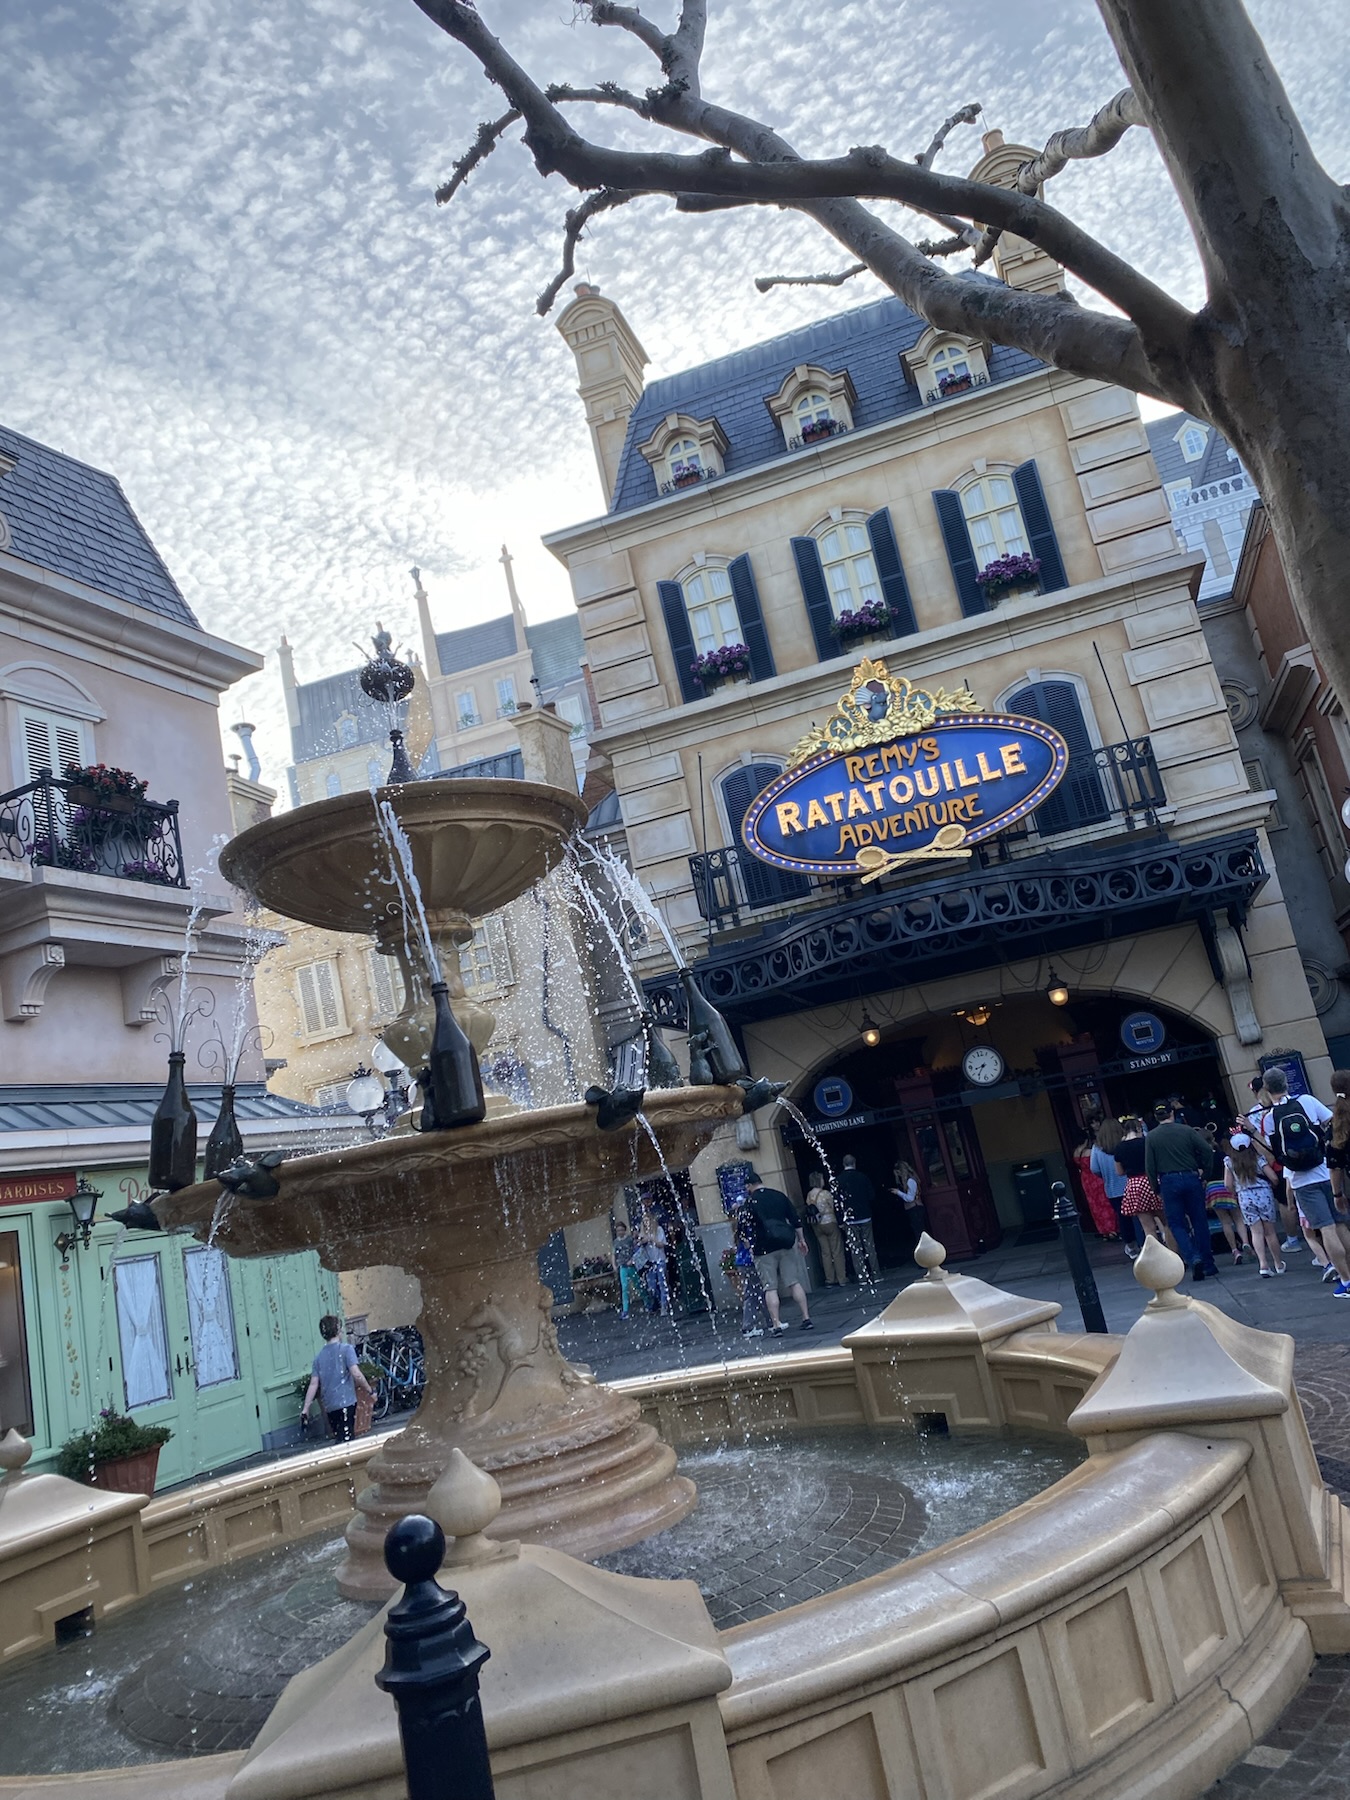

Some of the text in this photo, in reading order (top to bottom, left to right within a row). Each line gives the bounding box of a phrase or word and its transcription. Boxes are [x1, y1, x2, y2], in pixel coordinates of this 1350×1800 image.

[844, 737, 941, 782] REMY'S
[775, 743, 1027, 836] RATATOUILLE
[835, 793, 984, 855] ADVENTURE
[1130, 1054, 1171, 1069] STAND-BY
[815, 1116, 865, 1132] LIGHTNING LANE
[0, 1181, 65, 1200] ARDISES
